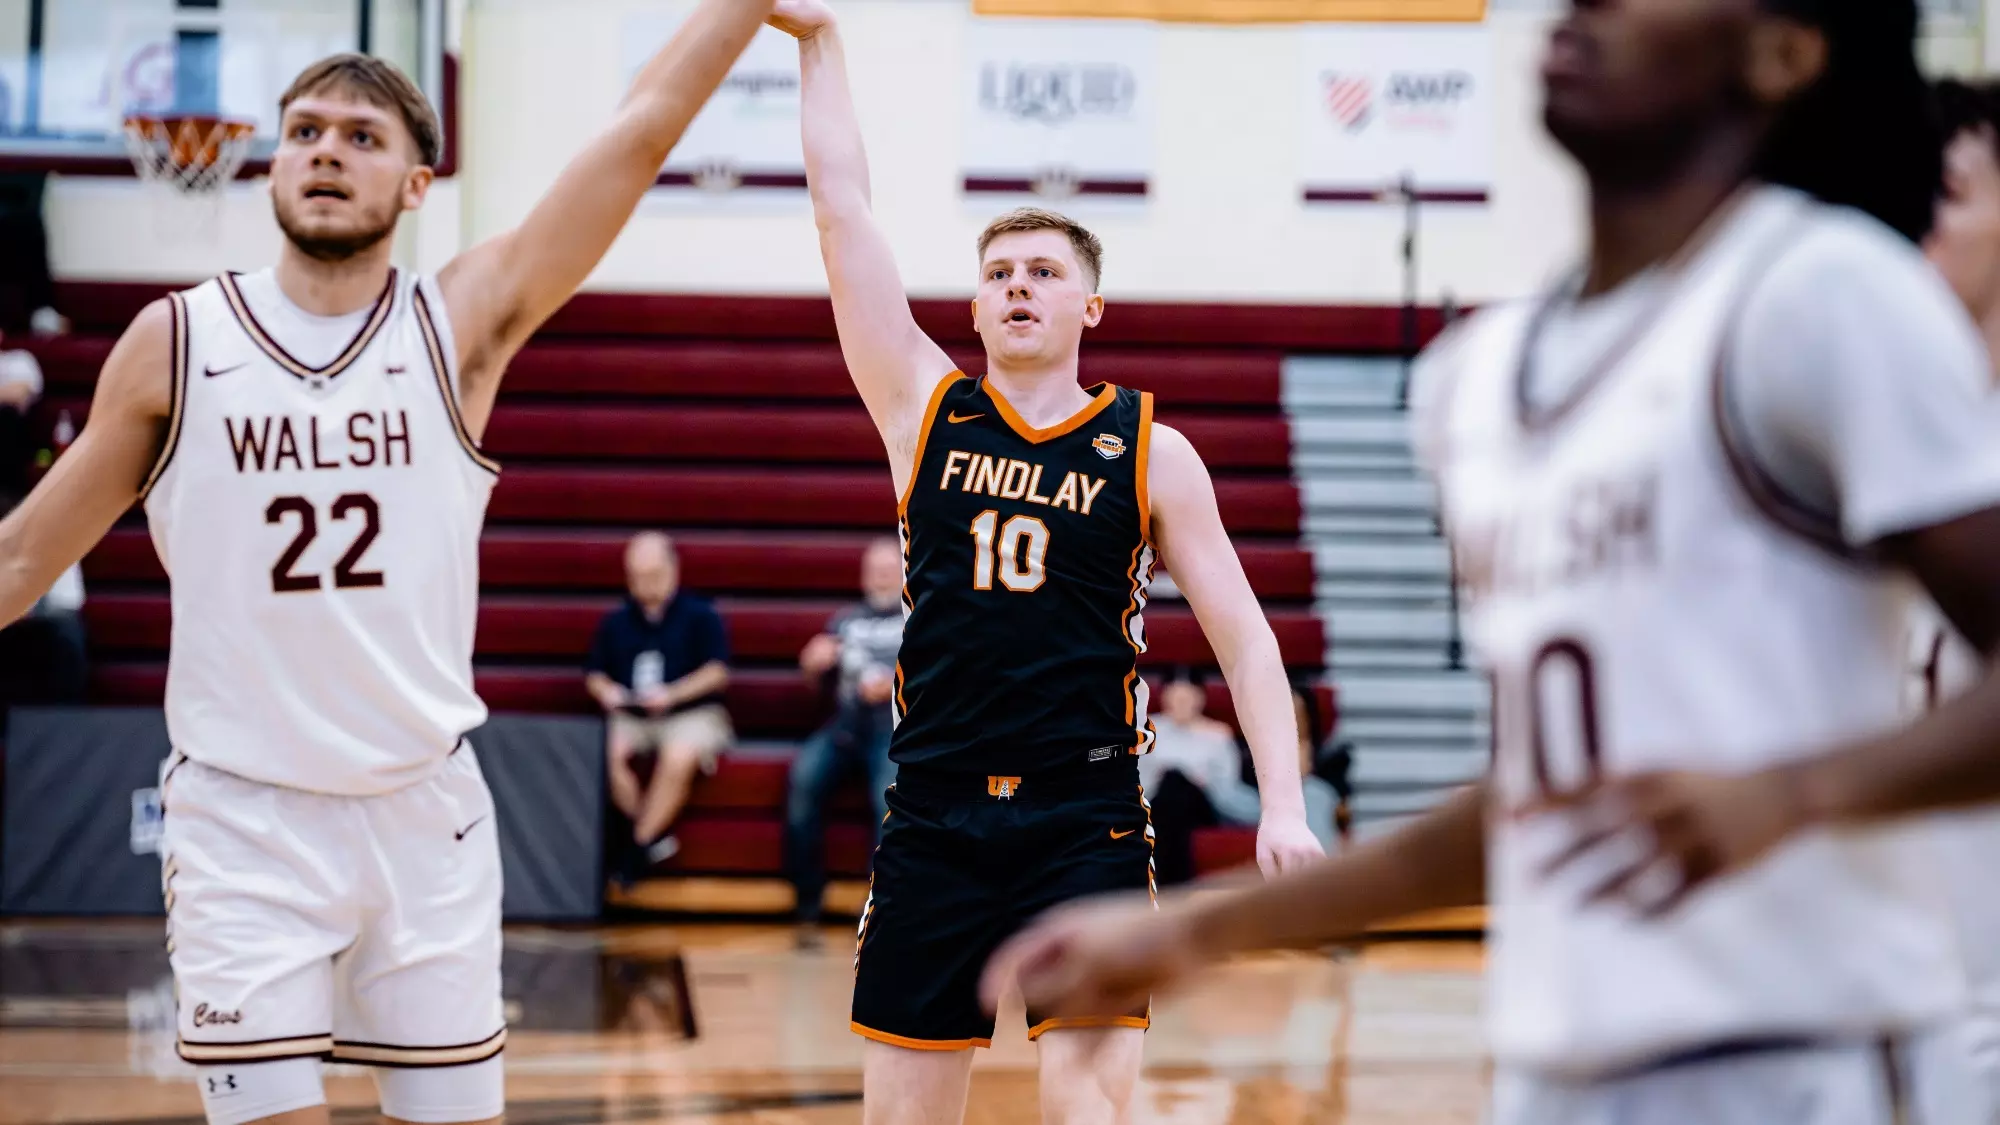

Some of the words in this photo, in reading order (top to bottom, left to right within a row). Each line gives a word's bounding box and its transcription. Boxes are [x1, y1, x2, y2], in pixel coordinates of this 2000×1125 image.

[224, 409, 413, 474] WALSH
[939, 450, 1107, 516] FINDLAY
[265, 492, 385, 593] 22
[969, 509, 1051, 593] 10
[193, 1002, 242, 1028] Cavs
